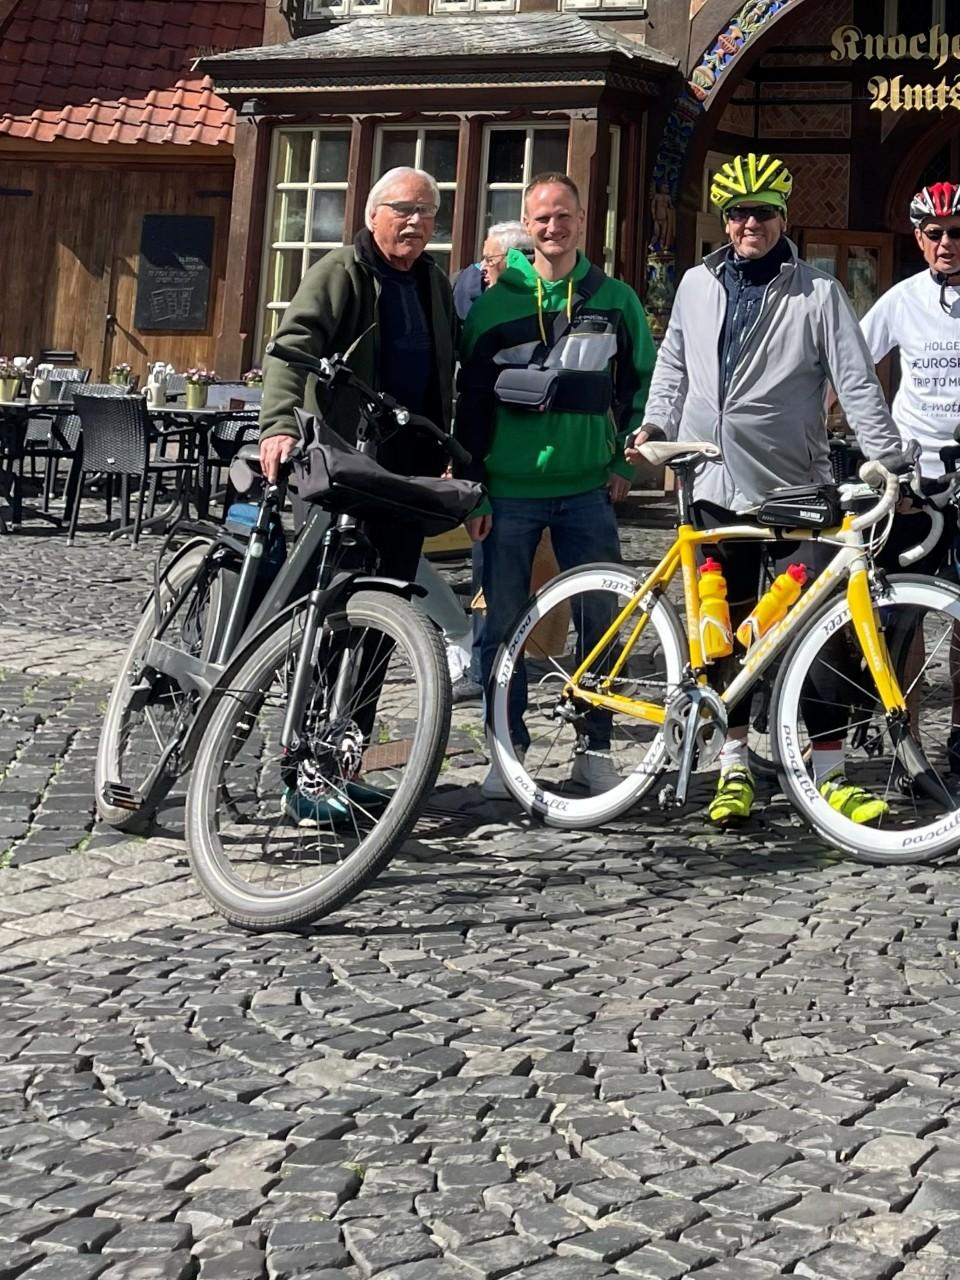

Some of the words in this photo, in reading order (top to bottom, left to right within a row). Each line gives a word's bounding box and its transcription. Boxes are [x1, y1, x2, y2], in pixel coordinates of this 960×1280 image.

[913, 377, 931, 388] TRIP
[932, 377, 946, 388] TO
[783, 724, 820, 802] pasculli
[515, 775, 570, 812] pasculli
